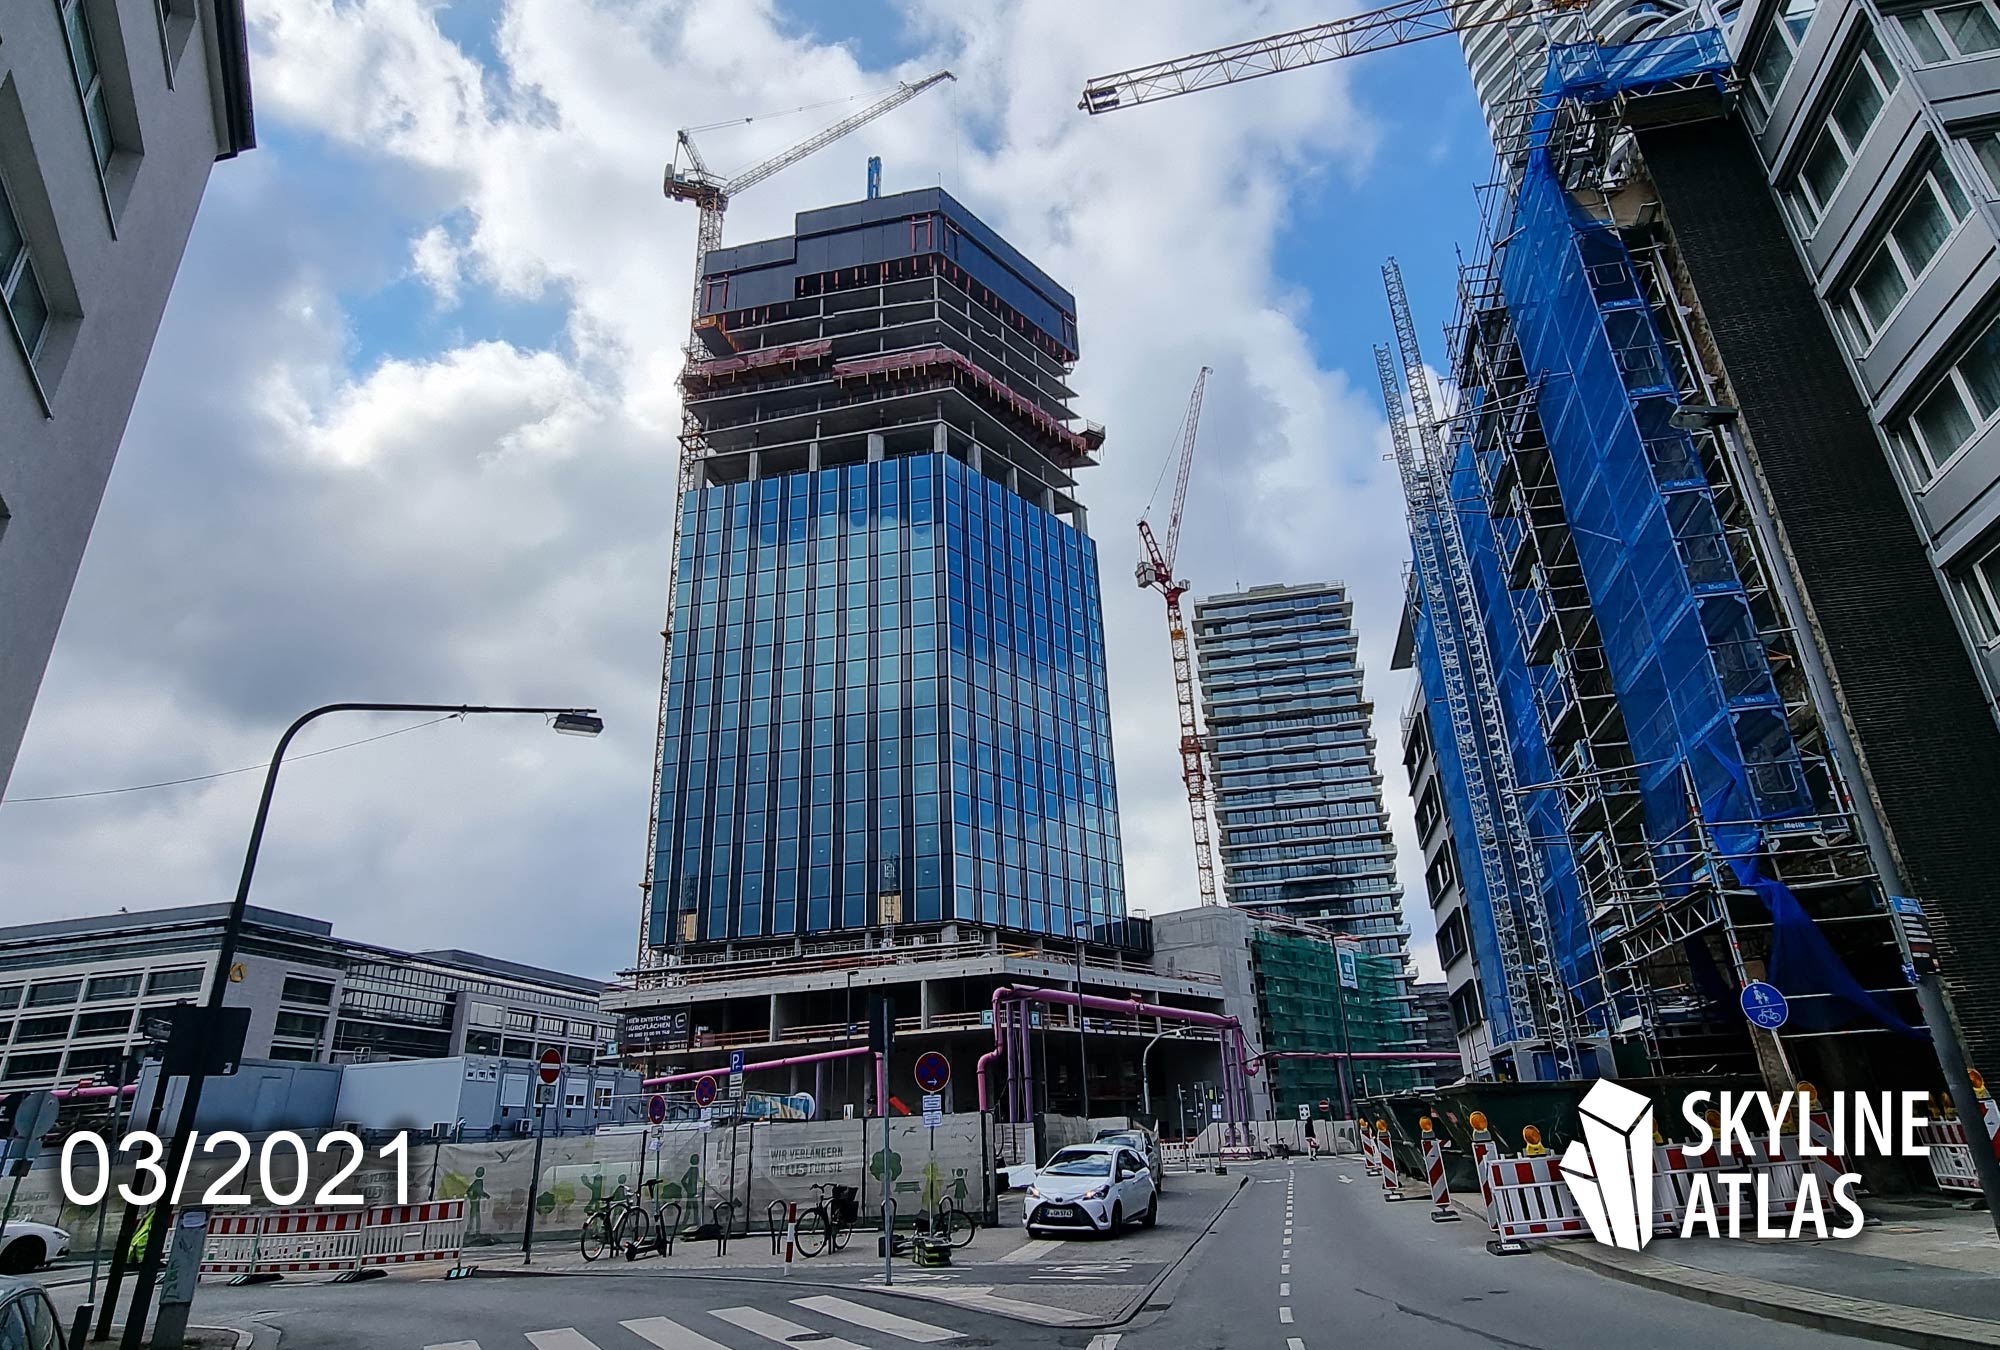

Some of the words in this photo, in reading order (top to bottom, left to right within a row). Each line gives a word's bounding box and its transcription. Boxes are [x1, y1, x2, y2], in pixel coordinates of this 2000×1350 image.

[732, 1053, 740, 1070] P
[770, 1148, 787, 1161] WIR
[828, 1161, 843, 1174] SIE
